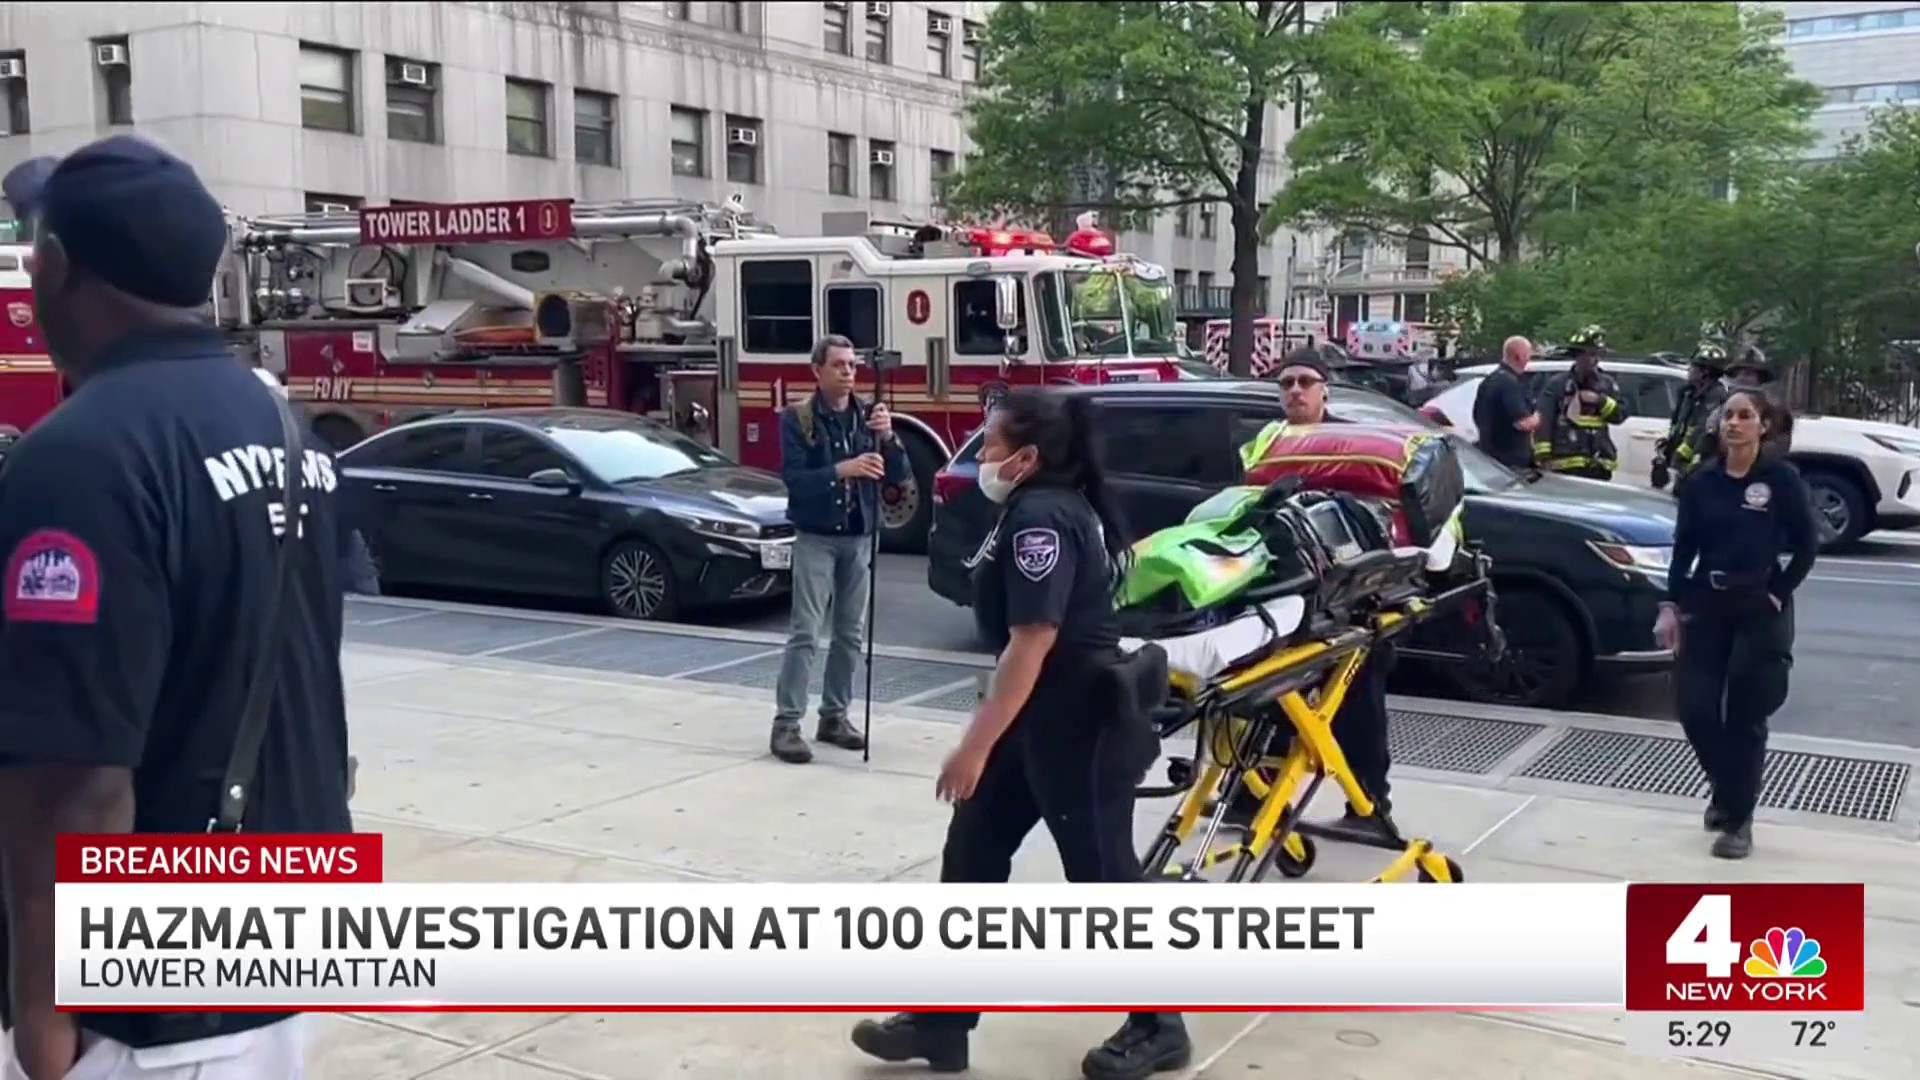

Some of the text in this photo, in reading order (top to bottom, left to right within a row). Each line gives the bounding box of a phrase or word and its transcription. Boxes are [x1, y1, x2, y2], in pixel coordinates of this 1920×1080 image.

[366, 206, 526, 239] TOWER LADDER 1
